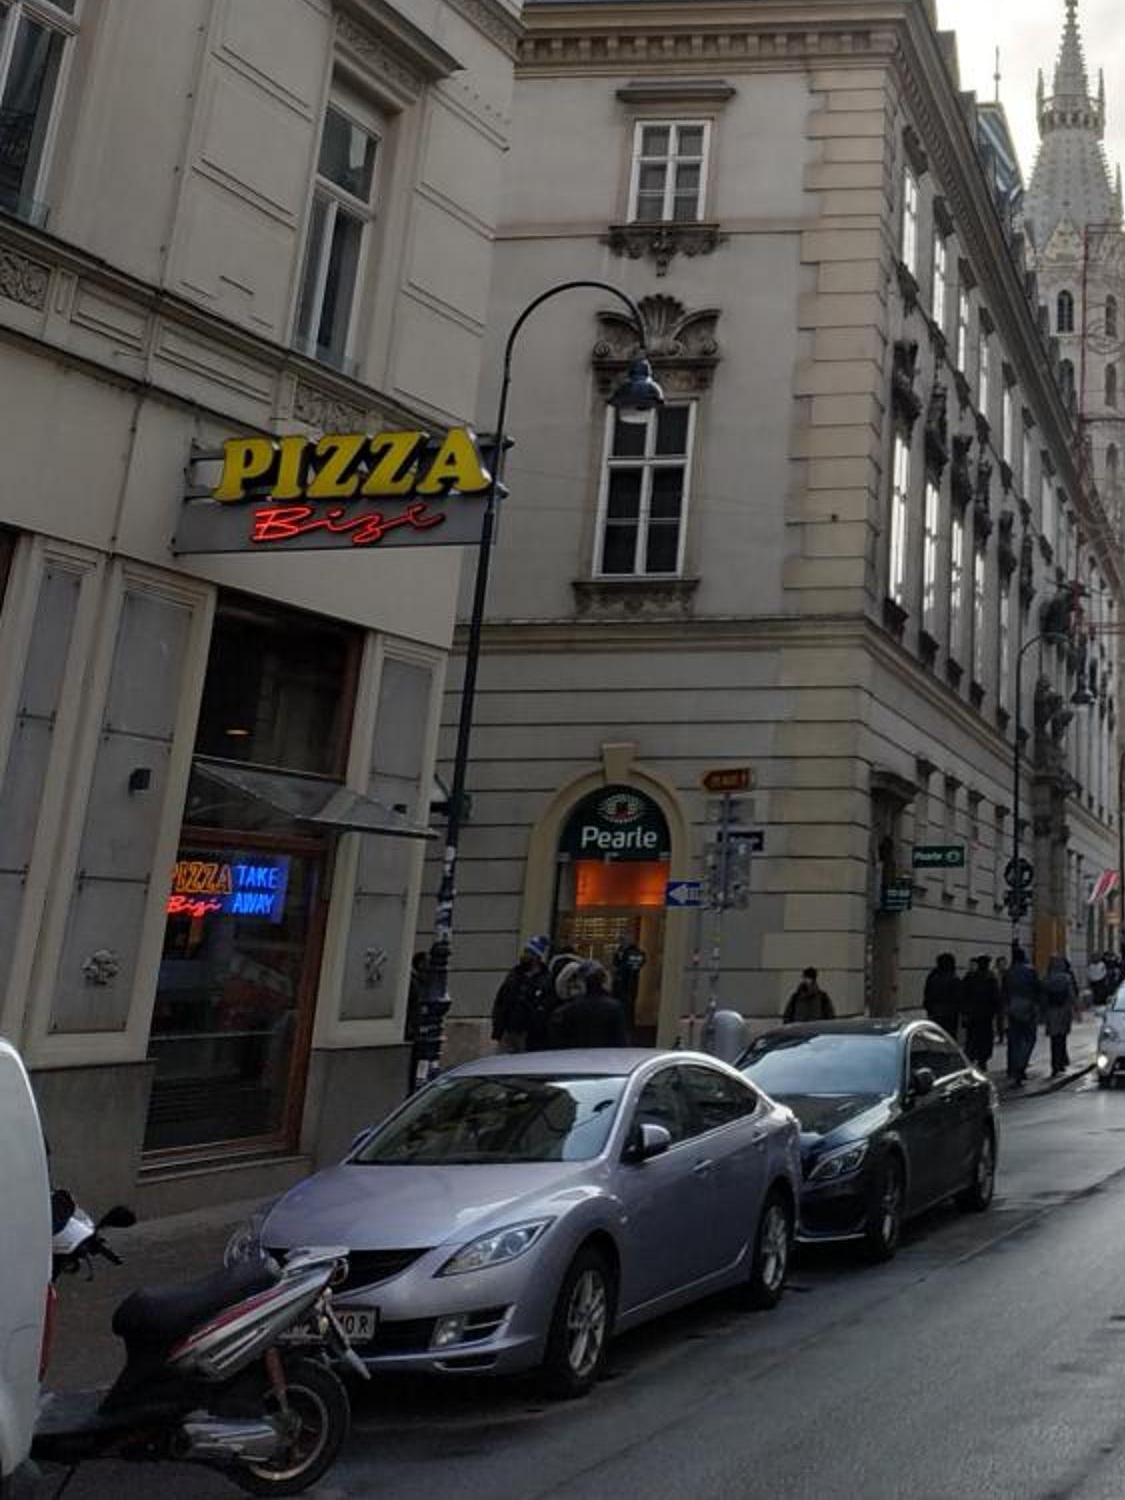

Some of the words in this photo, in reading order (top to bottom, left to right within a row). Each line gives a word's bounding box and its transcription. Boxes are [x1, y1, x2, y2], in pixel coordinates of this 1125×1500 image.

[212, 426, 492, 501] PIZZA
[252, 502, 446, 544] Bizi
[581, 826, 658, 849] Pearle
[236, 865, 281, 889] TAKE
[231, 892, 276, 914] AWAY
